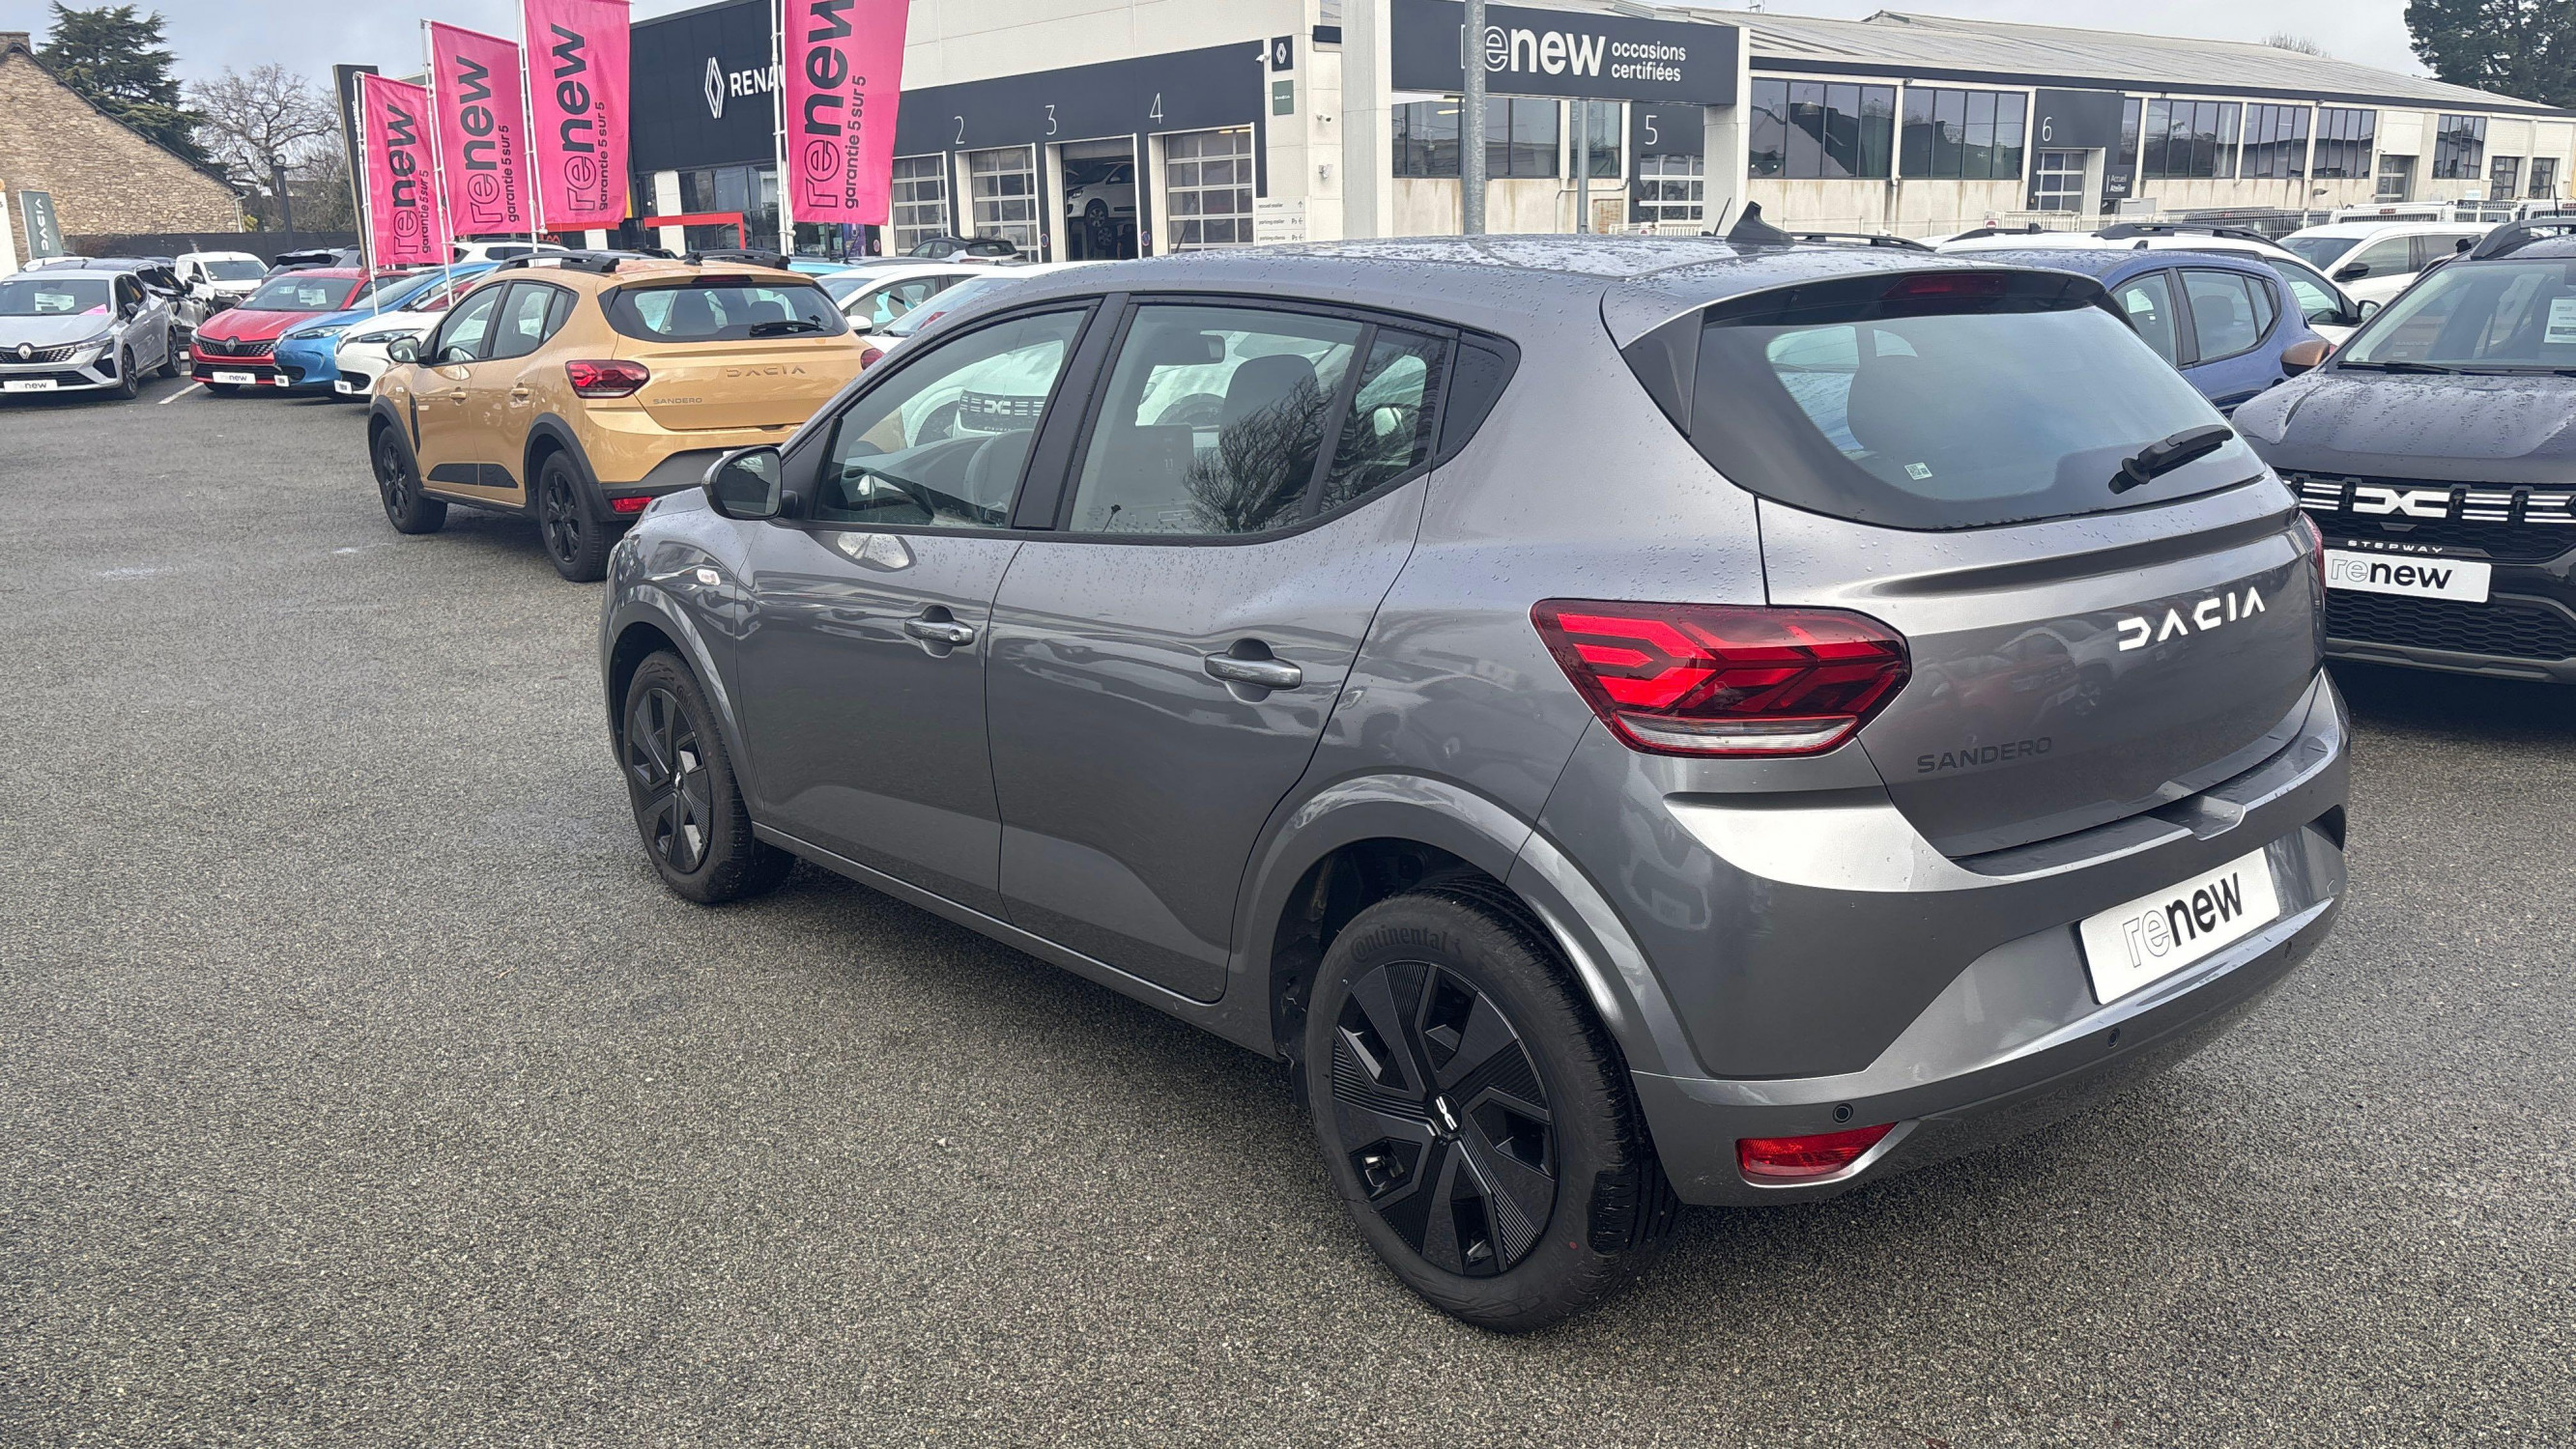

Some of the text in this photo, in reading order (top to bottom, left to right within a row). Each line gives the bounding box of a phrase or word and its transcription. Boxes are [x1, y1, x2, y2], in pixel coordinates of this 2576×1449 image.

[1461, 24, 1607, 76] enew
[1612, 41, 1686, 62] occasions
[1612, 61, 1681, 82] certifiées
[551, 22, 597, 211] renew
[804, 0, 855, 209] renew
[1045, 104, 1058, 135] 3
[1149, 93, 1164, 125] 4
[456, 55, 502, 223] renew
[499, 125, 509, 133] 5
[501, 134, 511, 156] sur
[844, 75, 866, 210] garantie 5 sur 5
[954, 116, 965, 145] 2
[1645, 115, 1658, 145] 5
[2042, 116, 2052, 142] 6
[595, 101, 609, 211] garantie 5 sur 5
[387, 103, 419, 255] renew
[501, 168, 520, 222] garantie
[418, 204, 431, 253] garantie
[726, 365, 806, 378] DACIA
[2347, 540, 2444, 554] STEPWAY
[2331, 558, 2452, 589] renew
[2118, 586, 2267, 652] DACIA
[1917, 736, 2052, 774] SANDERO
[2123, 872, 2244, 968] renew
[1350, 923, 1448, 963] Continental
